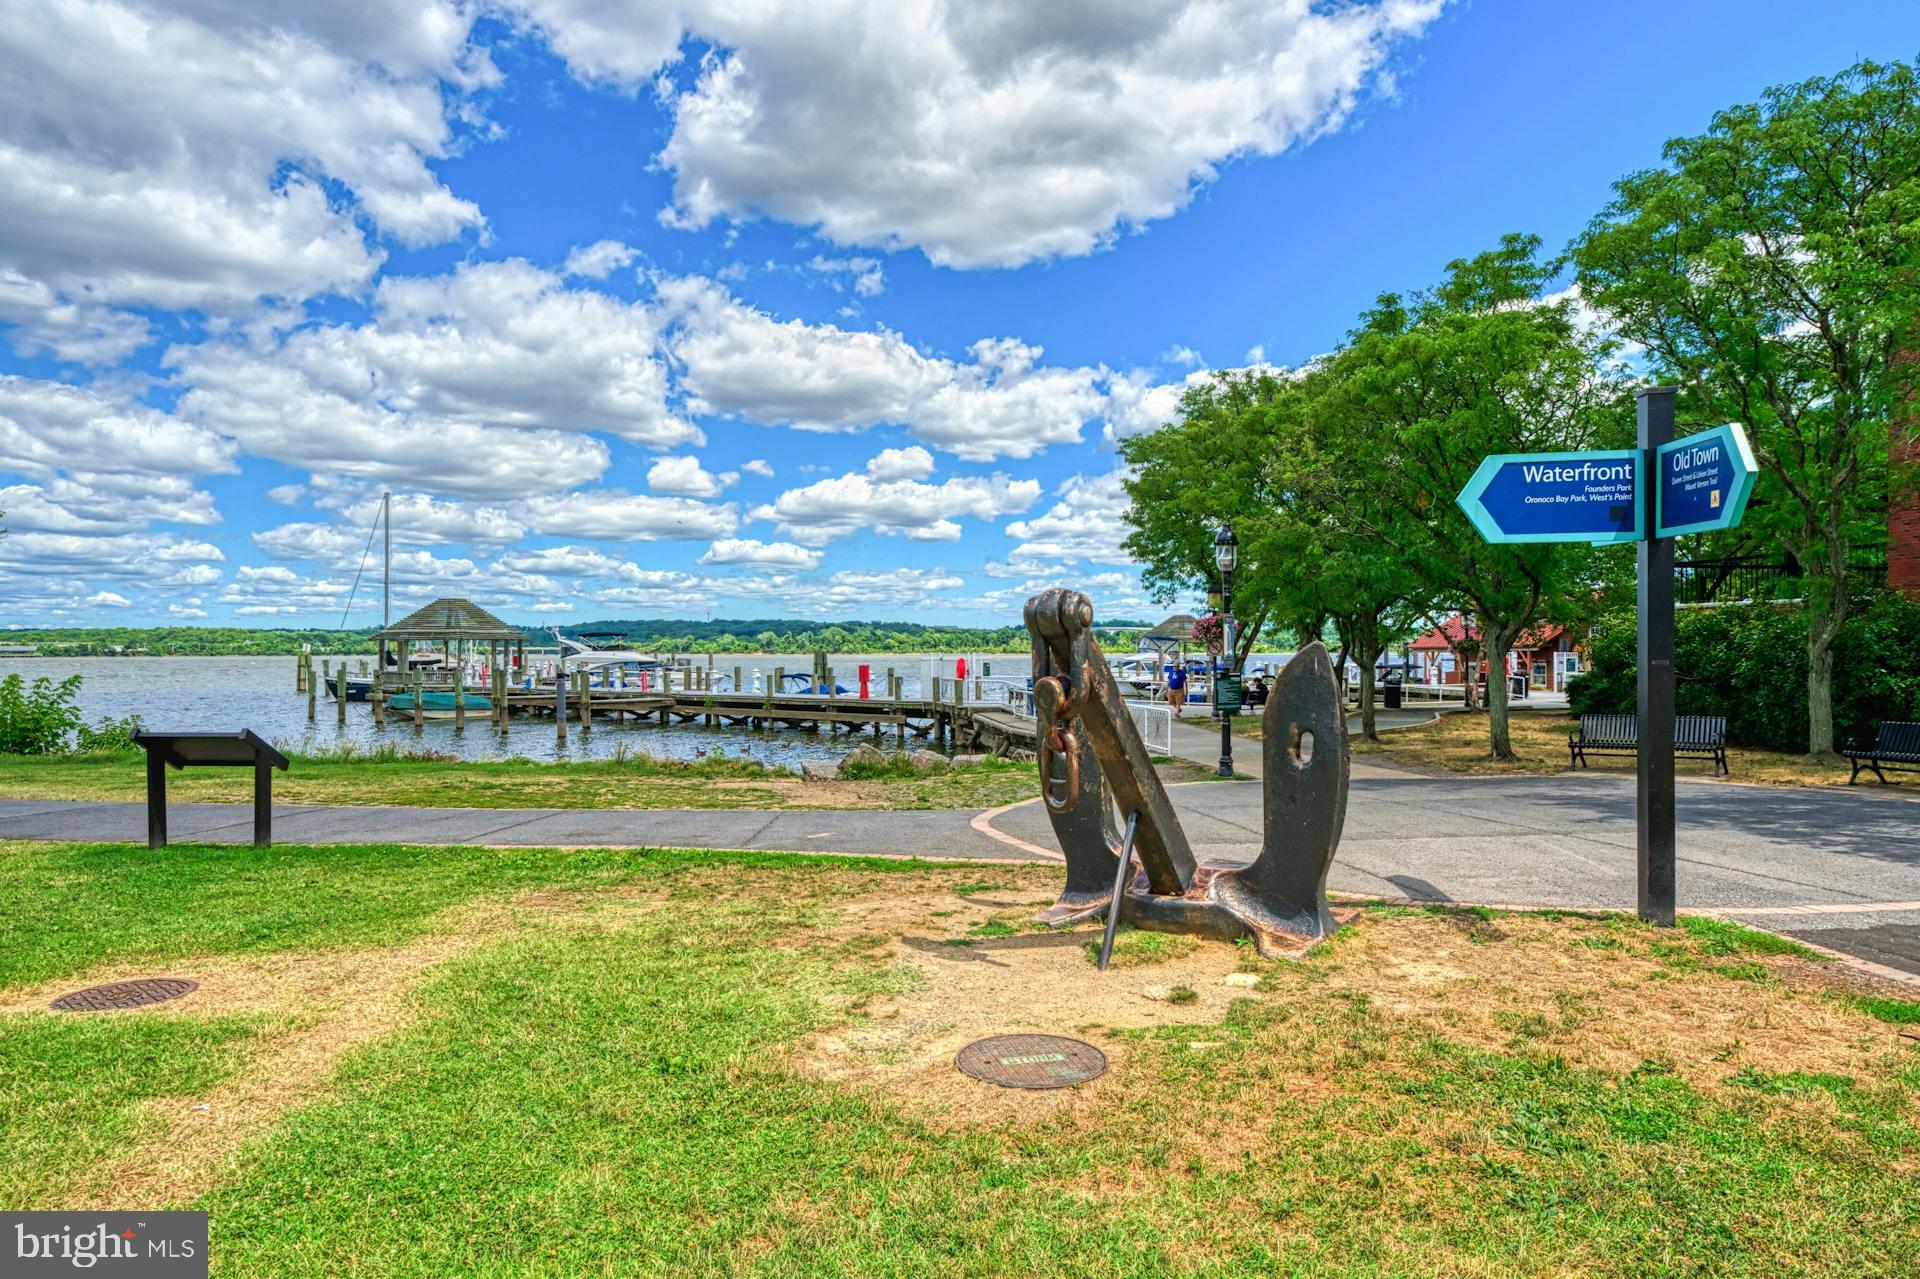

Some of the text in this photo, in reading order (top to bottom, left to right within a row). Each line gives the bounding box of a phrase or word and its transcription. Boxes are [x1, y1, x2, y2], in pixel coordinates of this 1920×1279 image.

[1673, 447, 1719, 472] Old Town
[1523, 462, 1632, 483] Waterfront
[1709, 476, 1718, 486] Trail
[1584, 484, 1632, 493] Founders Park
[1525, 493, 1632, 504] Oronoco Bay Park, West's Point
